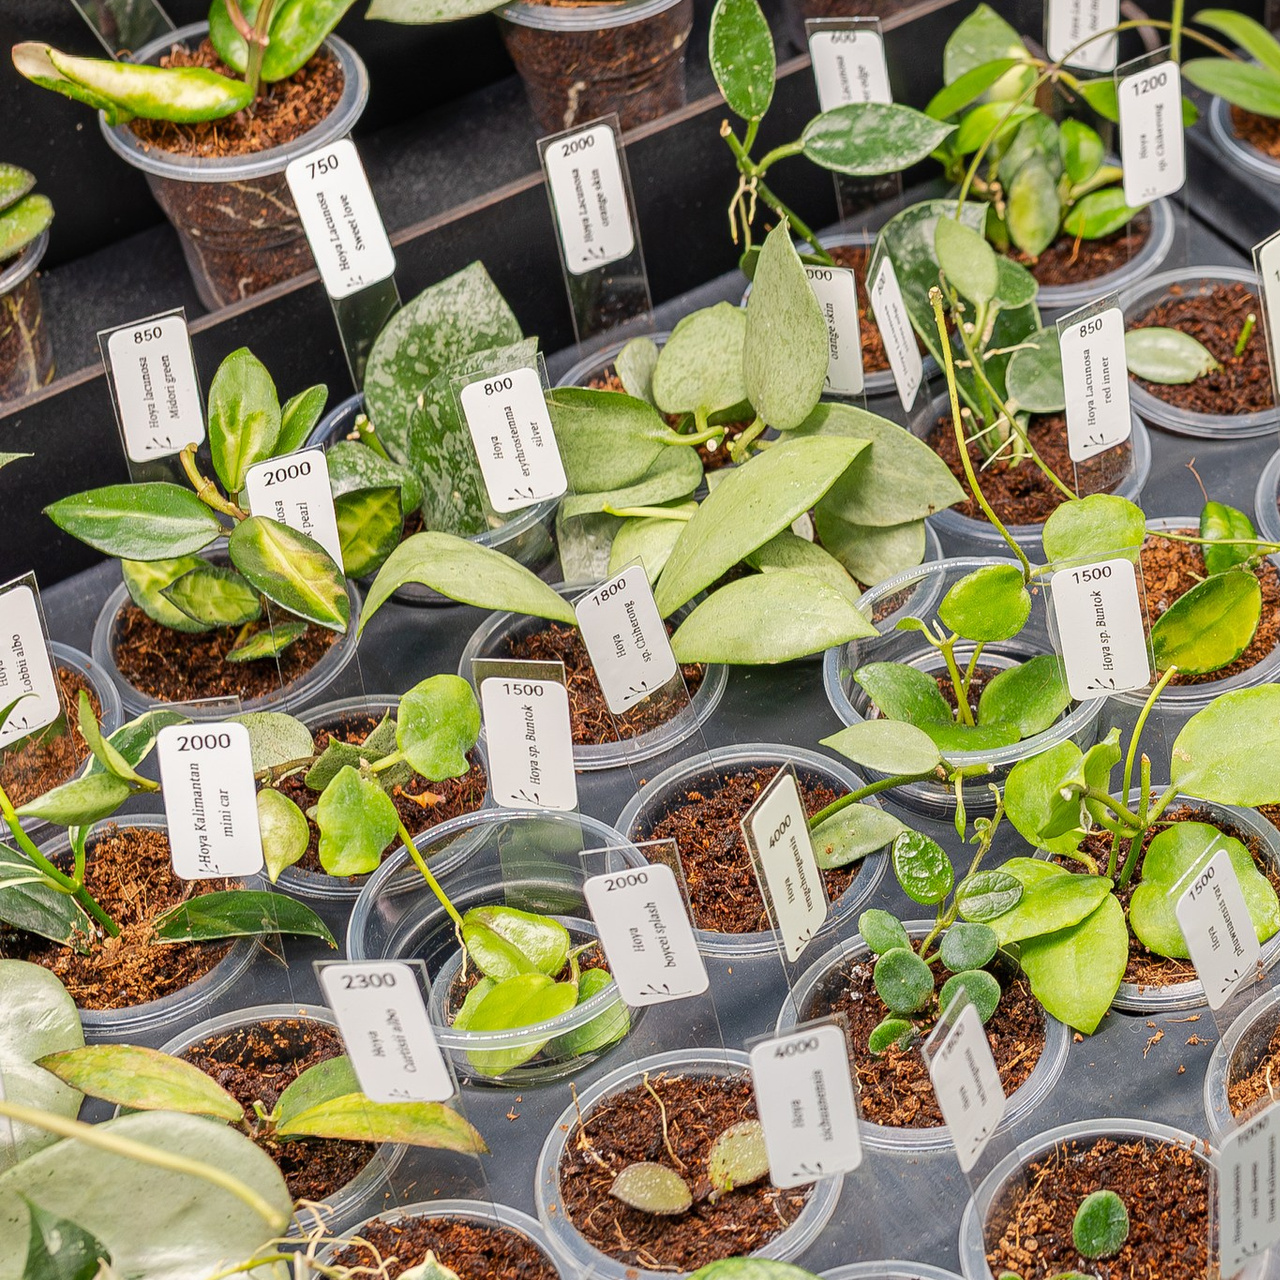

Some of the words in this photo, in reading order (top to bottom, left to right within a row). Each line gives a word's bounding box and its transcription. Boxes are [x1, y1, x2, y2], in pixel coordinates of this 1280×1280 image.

[1132, 72, 1168, 96] 1200
[561, 134, 595, 158] 2000
[1140, 134, 1148, 159] Hoya
[305, 154, 339, 180] 750
[591, 168, 602, 191] skin
[572, 168, 588, 216] Lacunosa
[316, 192, 340, 242] Lacunosa
[340, 194, 354, 218] love
[596, 192, 609, 227] orange
[348, 219, 366, 251] Sweet
[582, 217, 594, 243] Hoya
[335, 243, 350, 271] Hoya
[824, 302, 835, 324] skin
[134, 326, 162, 344] 850
[1079, 318, 1103, 338] 850
[826, 326, 840, 363] orange
[139, 356, 154, 401] lacunosa
[161, 355, 176, 384] green
[1083, 348, 1094, 398] Lacunosa
[1102, 357, 1110, 385] inner
[484, 377, 513, 396] 800
[1102, 386, 1112, 404] red
[166, 385, 179, 418] Midori
[1087, 400, 1097, 426] Hoya
[148, 403, 159, 428] Hoya
[504, 406, 530, 477] erythrostemma
[530, 422, 544, 447] silver
[490, 436, 504, 460] Hoya
[263, 461, 311, 487] 2000
[296, 502, 314, 528] pearl
[1072, 566, 1112, 584] 1500
[588, 578, 626, 606] 1800
[1090, 590, 1106, 627] Buntok
[624, 600, 646, 649] Chiherong
[1100, 630, 1111, 644] sp.
[11, 634, 24, 658] albo
[612, 634, 626, 658] Hoya
[642, 649, 652, 663] sp.
[1102, 646, 1114, 671] Hoya
[16, 658, 33, 693] Lobbii
[502, 683, 544, 697] 1500
[521, 704, 536, 742] Buntok
[177, 733, 231, 752] 2000
[528, 744, 540, 758] sp.
[529, 760, 542, 785] Hoya
[190, 763, 207, 832] Kalimantan
[219, 789, 230, 807] car
[222, 810, 234, 837] mini
[769, 814, 792, 848] 4000
[198, 835, 212, 864] Hoya
[604, 872, 648, 892] 2000
[788, 834, 812, 912] tengchongensis
[1184, 863, 1219, 901] 1500
[784, 877, 795, 904] Hoya
[1212, 884, 1222, 901] var
[644, 902, 666, 934] splash
[629, 927, 645, 952] Hoya
[1208, 926, 1220, 951] Hoya
[658, 936, 676, 968] boycei
[341, 972, 397, 990] 2300
[386, 1008, 402, 1032] albo
[368, 1031, 386, 1057] Hoya
[774, 1037, 819, 1059] 4000
[791, 1099, 804, 1128] Hoya
